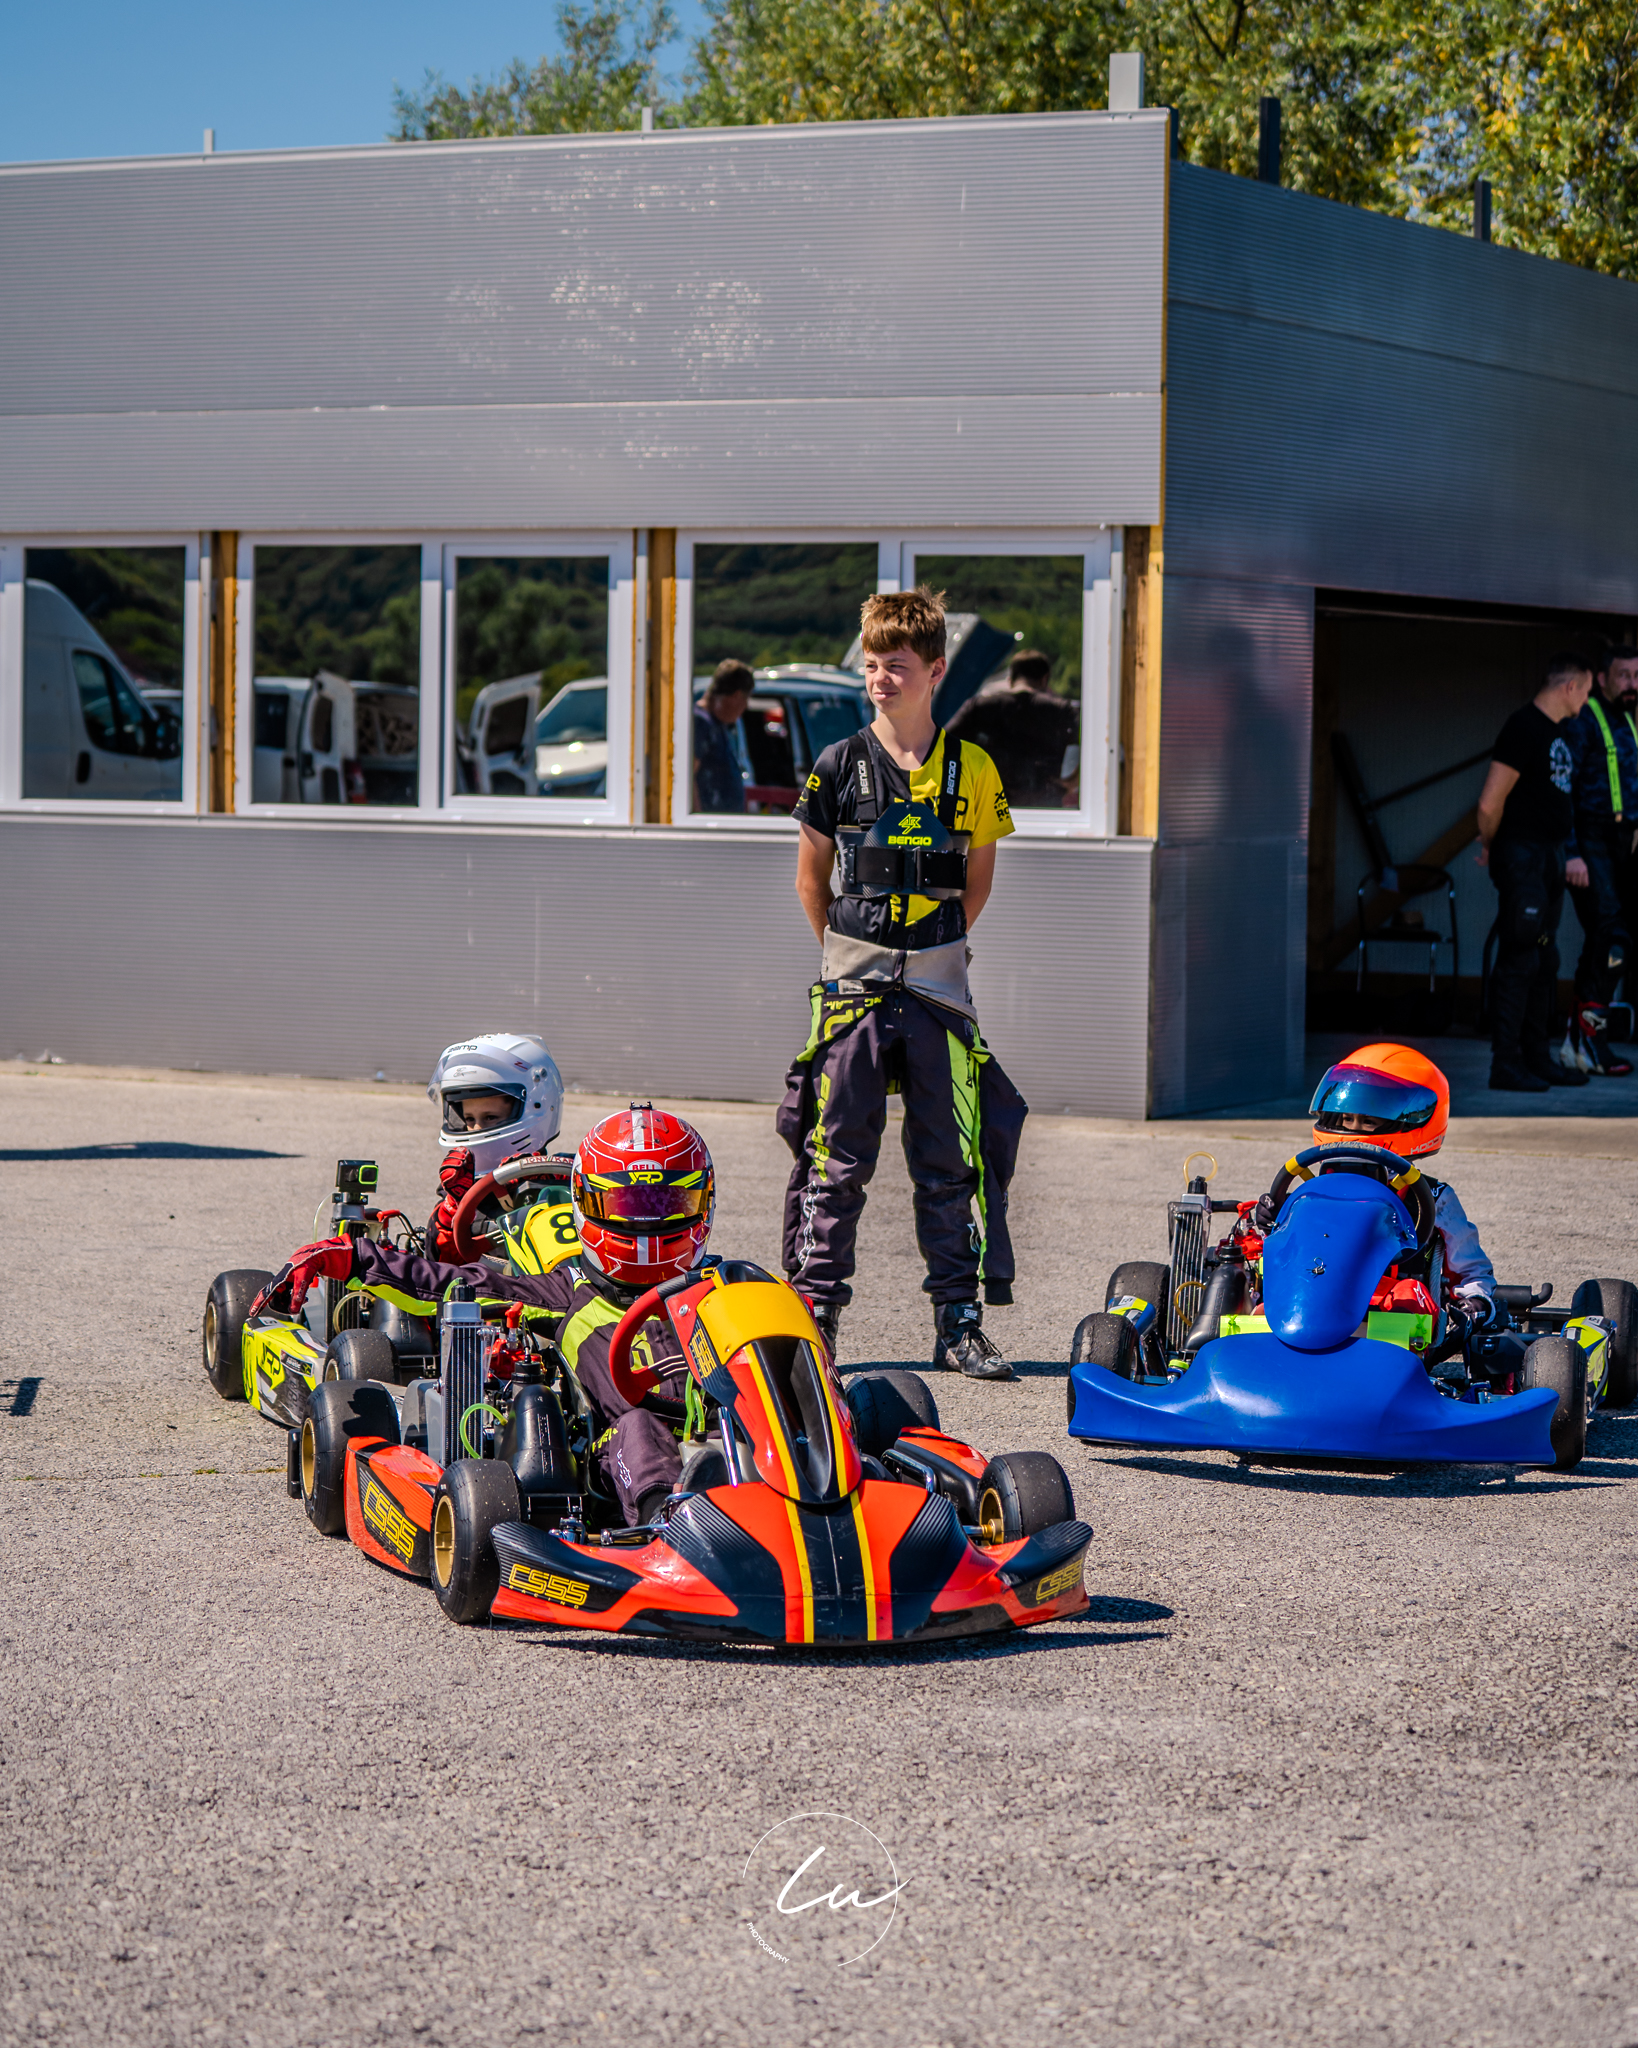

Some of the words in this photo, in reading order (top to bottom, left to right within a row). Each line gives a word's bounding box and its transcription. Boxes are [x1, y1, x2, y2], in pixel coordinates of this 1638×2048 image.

[857, 760, 870, 795] BENGIO
[946, 760, 957, 796] BENGIO
[887, 835, 933, 847] BENGIO
[553, 1156, 574, 1165] KAR
